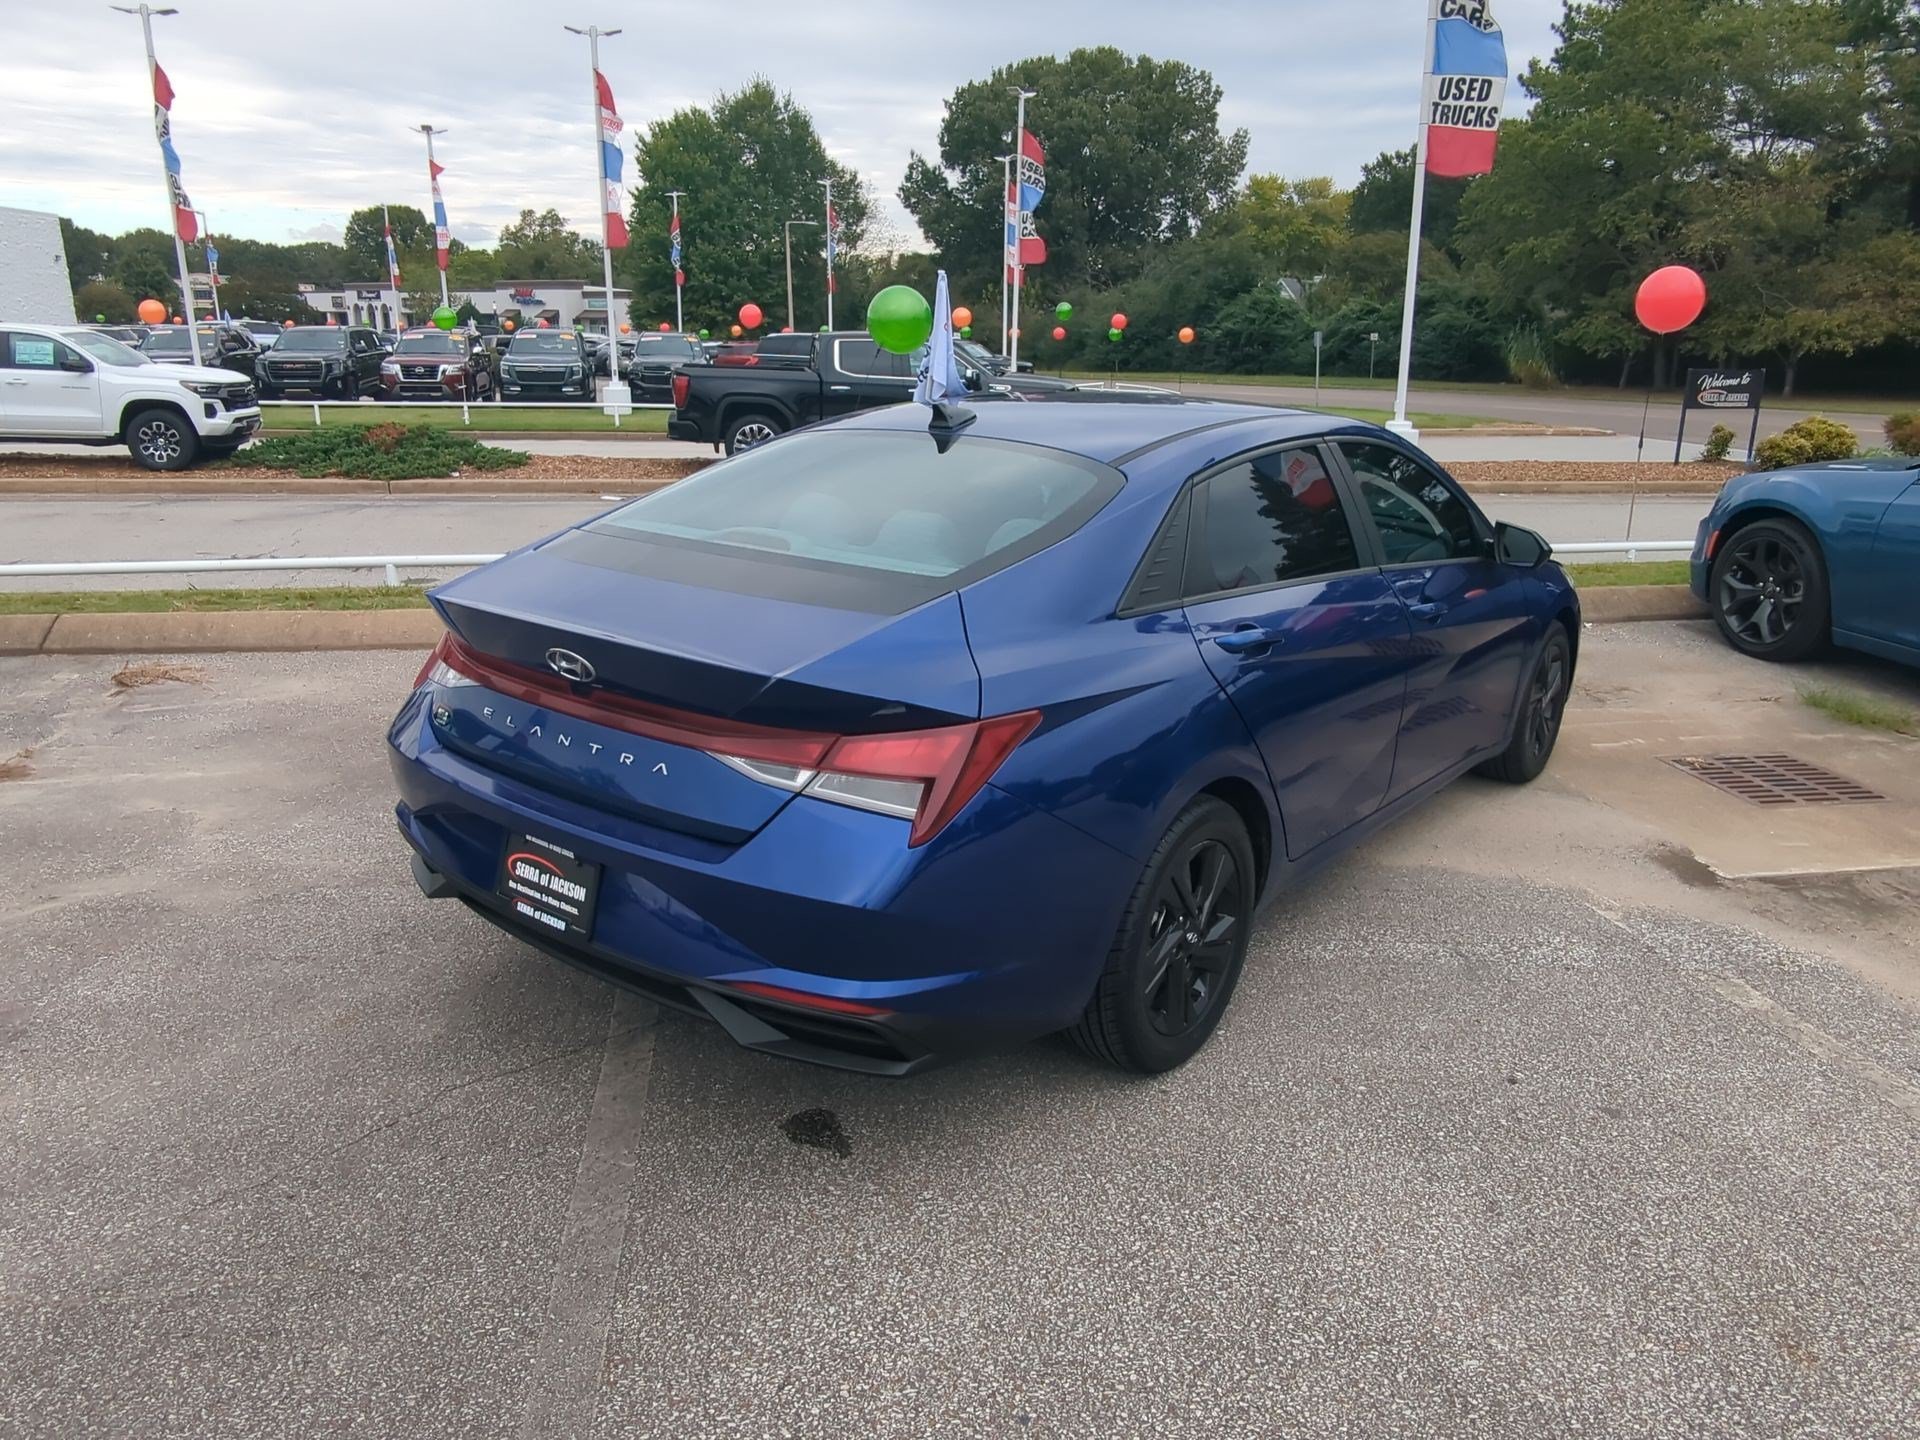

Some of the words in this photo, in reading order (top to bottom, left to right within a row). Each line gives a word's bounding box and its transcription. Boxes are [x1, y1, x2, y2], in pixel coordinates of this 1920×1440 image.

[1438, 77, 1493, 103] USED
[1431, 101, 1499, 128] TRUCKS
[1697, 373, 1740, 391] Welcome
[1741, 372, 1752, 385] to
[483, 706, 669, 776] ELANTRA
[515, 861, 539, 884] SERRA
[540, 873, 550, 887] of
[549, 875, 587, 902] JACKSON
[516, 901, 535, 917] SERRA
[534, 910, 542, 920] of
[540, 911, 567, 932] JACKSON
